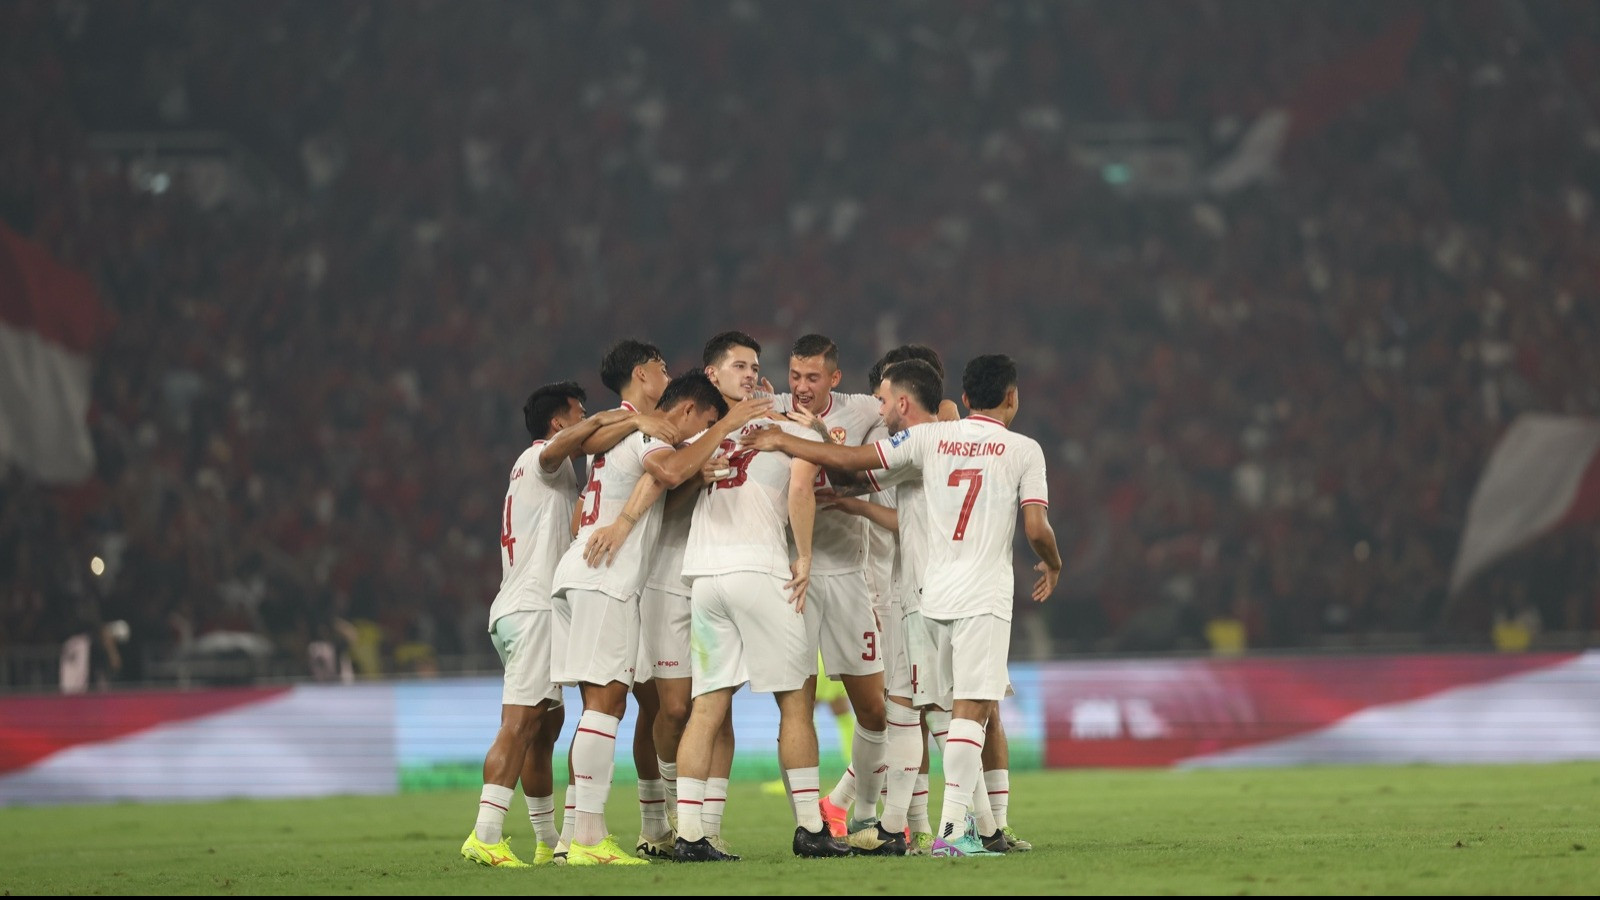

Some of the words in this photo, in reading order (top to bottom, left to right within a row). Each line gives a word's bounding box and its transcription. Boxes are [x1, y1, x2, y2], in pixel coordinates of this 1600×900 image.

[937, 439, 1006, 457] MARSELINO
[501, 494, 516, 567] 4
[947, 468, 984, 541] 7
[861, 631, 876, 662] 3
